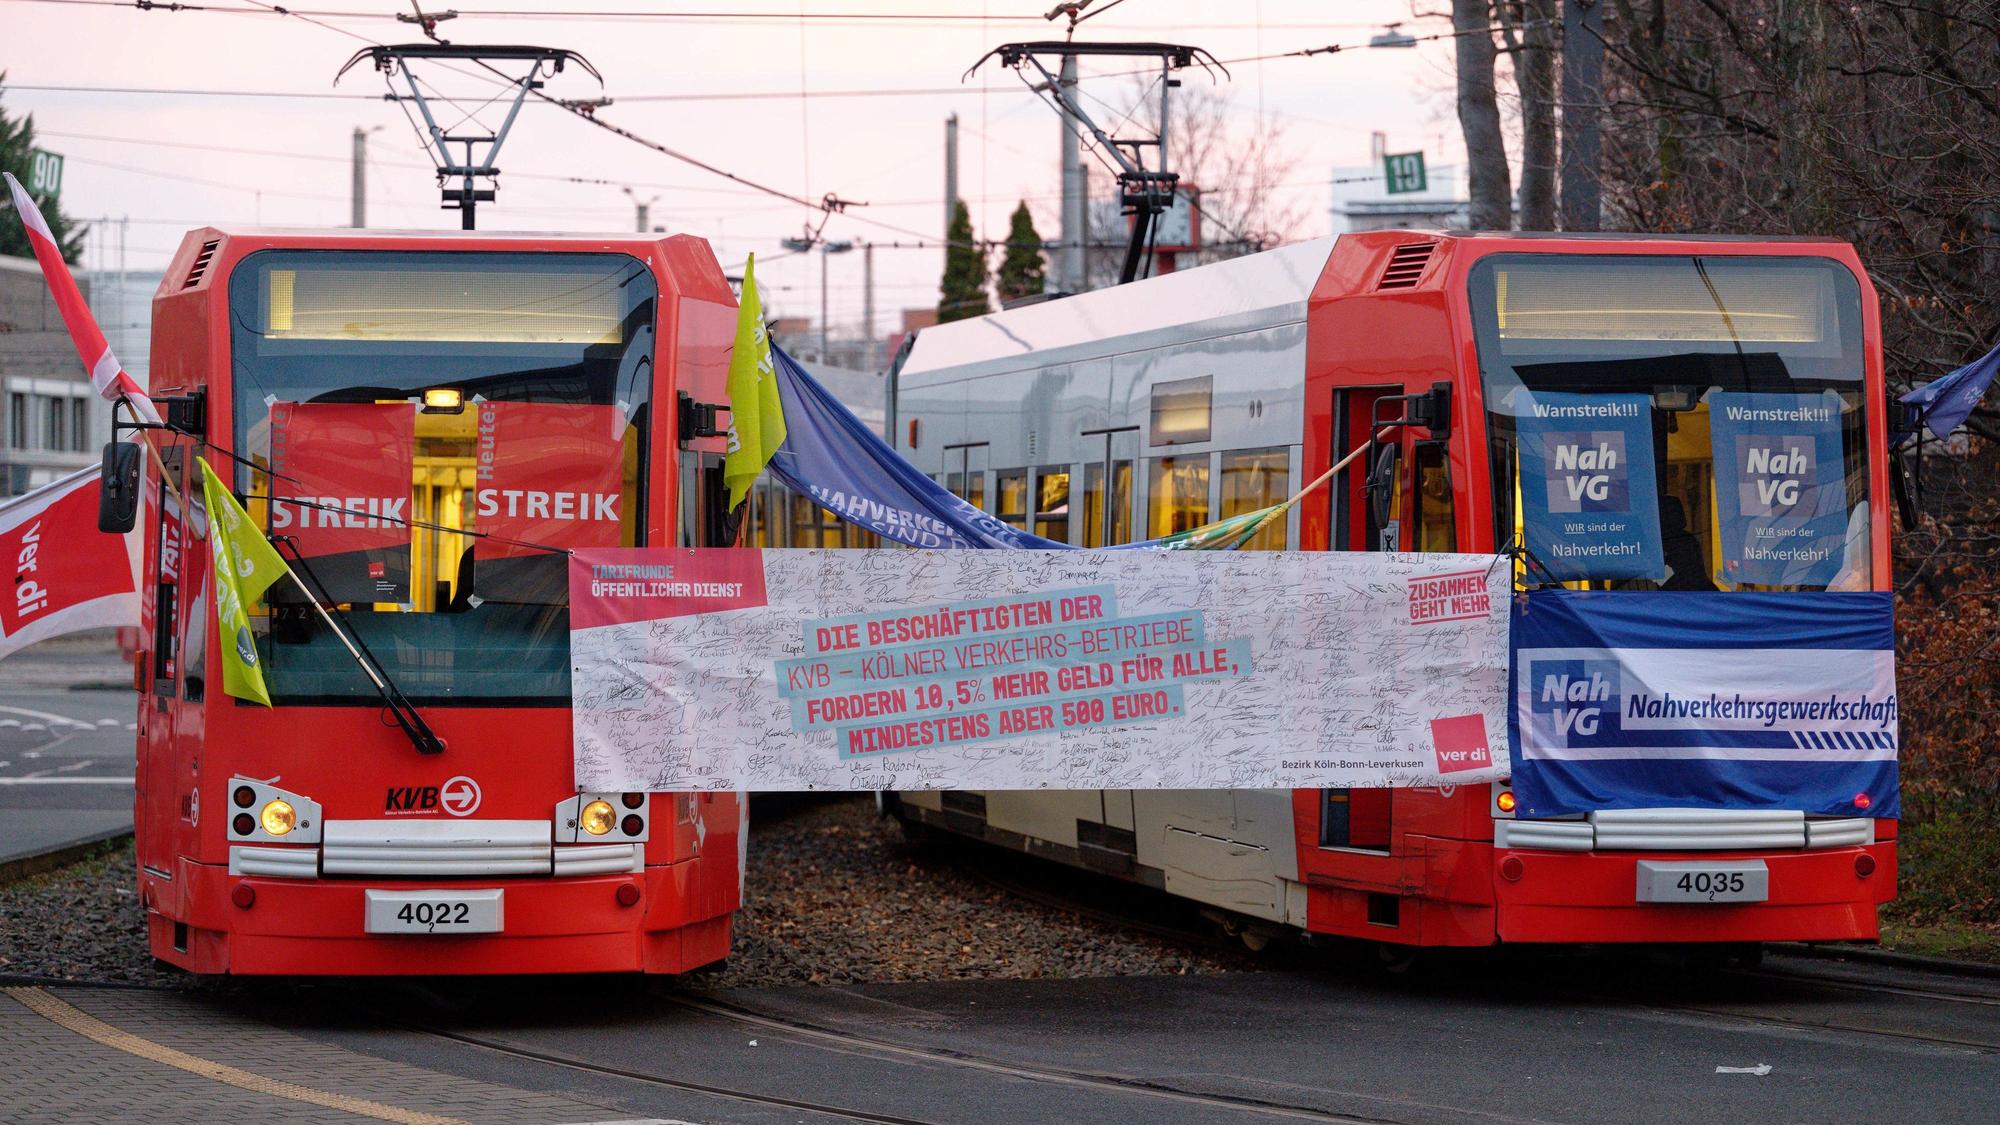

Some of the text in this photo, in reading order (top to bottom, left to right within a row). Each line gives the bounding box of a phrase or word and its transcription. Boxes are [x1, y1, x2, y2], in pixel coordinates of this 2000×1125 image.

[33, 151, 60, 193] 90
[1533, 403, 1639, 418] Warnstreik!!!
[1726, 406, 1829, 422] Warnstreik!!!
[477, 402, 496, 480] Heute:
[1554, 442, 1617, 470] Nah
[1746, 447, 1807, 475] Nah
[1565, 475, 1610, 501] VG
[1757, 479, 1800, 506] VG
[273, 496, 407, 529] STREIK
[477, 488, 620, 521] STREIK
[1564, 522, 1626, 533] WIR sind der
[1755, 527, 1815, 537] WIR sind der
[1552, 541, 1641, 557] Nahverkehr!
[1744, 547, 1829, 561] Nahverkehr!
[15, 519, 48, 618] ver.di
[592, 564, 674, 580] TARIFRUNDE
[592, 580, 743, 598] ÖFFENTLICHER DIENST
[1408, 574, 1488, 602] ZUSAMMEN
[1409, 594, 1490, 620] GEHT MEHR
[816, 623, 861, 652] DIE
[867, 600, 1052, 646] BESCHÄFTIGTEN
[1060, 594, 1103, 622] DER
[787, 663, 831, 691] KVB
[861, 648, 947, 682] KÖLNER
[954, 618, 1195, 670] VERKEHRS-BETRIEBE
[807, 648, 1239, 724] FORDERN 10,5% MEHR GELD FÜR ALLE,
[1541, 671, 1611, 703] Nah
[848, 712, 991, 754] MINDESTENS
[999, 705, 1055, 735] ABER
[1062, 698, 1105, 727] 500
[1112, 690, 1180, 721] EURO.
[1553, 707, 1601, 737] VG
[1628, 693, 1896, 728] Nahverkehrsgewerkschaft
[1282, 759, 1424, 769] Bezirk Köln-Bonn-Leverkusen
[1439, 747, 1487, 762] ver.di
[385, 786, 439, 810] KVB
[1677, 872, 1745, 893] 4035
[397, 903, 470, 924] 4022
